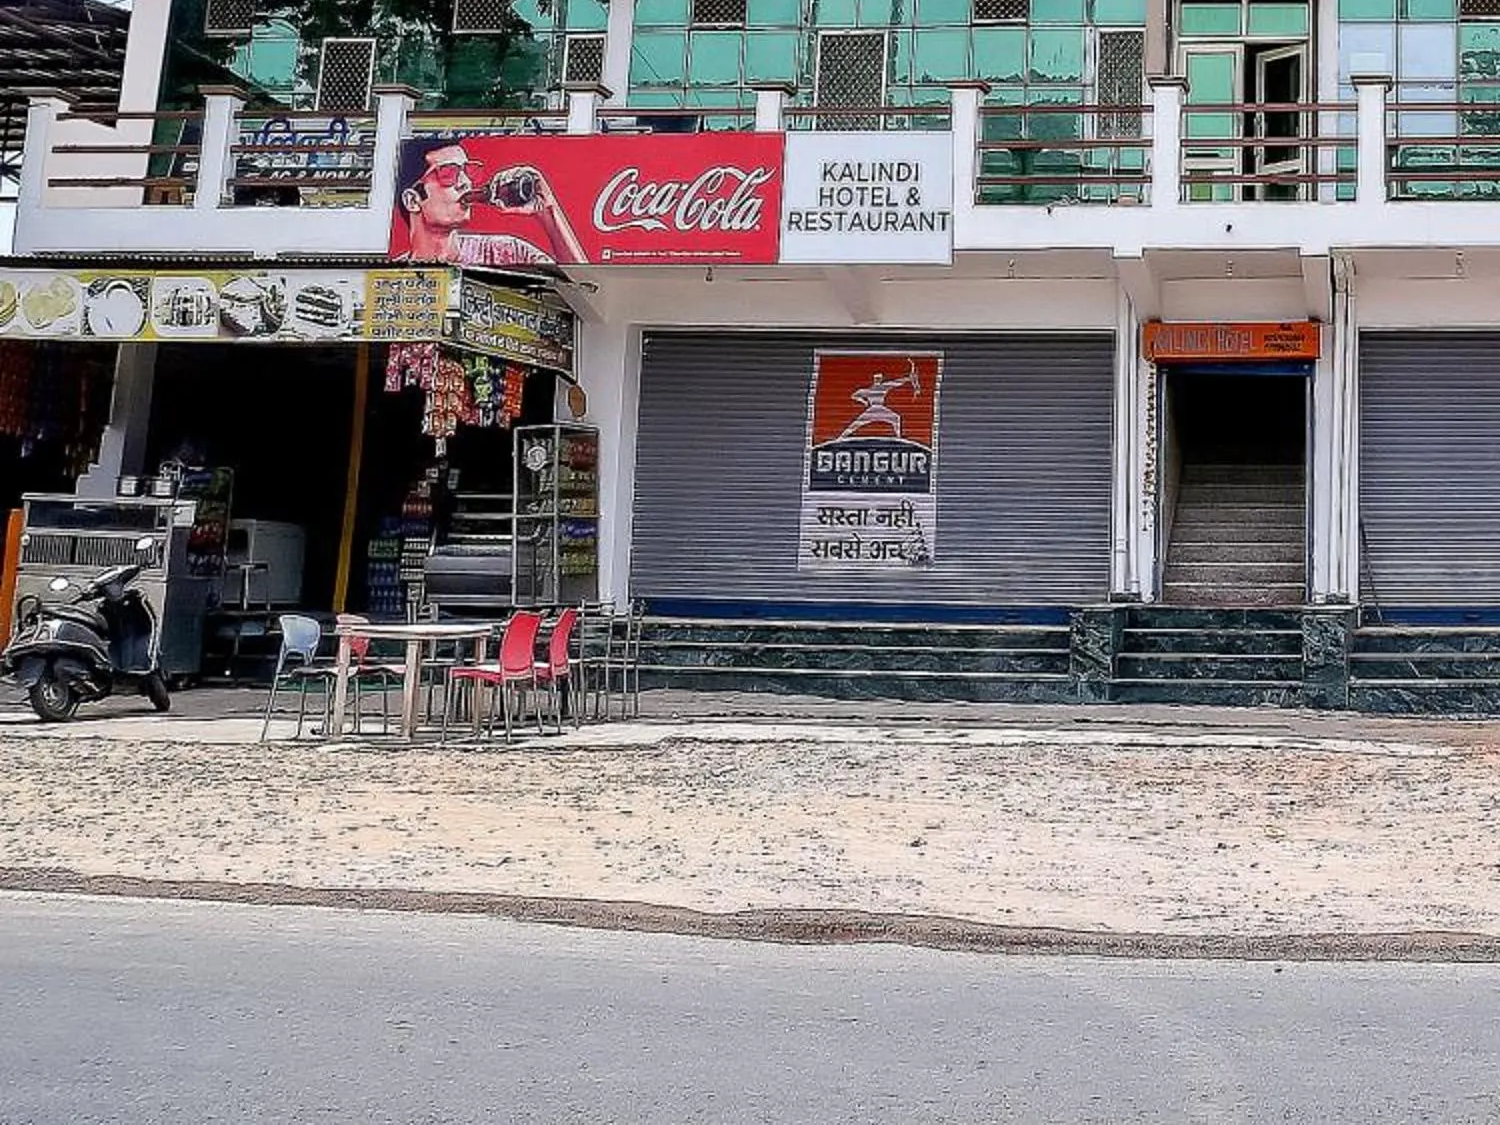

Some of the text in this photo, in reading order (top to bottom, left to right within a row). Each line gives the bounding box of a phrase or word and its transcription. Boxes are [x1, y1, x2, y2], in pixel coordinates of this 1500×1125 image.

[822, 162, 920, 183] KALINDI
[593, 165, 776, 234] Coca-Cola
[819, 187, 922, 207] HOTEL &
[788, 211, 950, 232] RESTAURANT
[816, 451, 927, 474] BANGUR
[817, 507, 870, 526] सस्ता
[811, 533, 864, 559] सबसे
